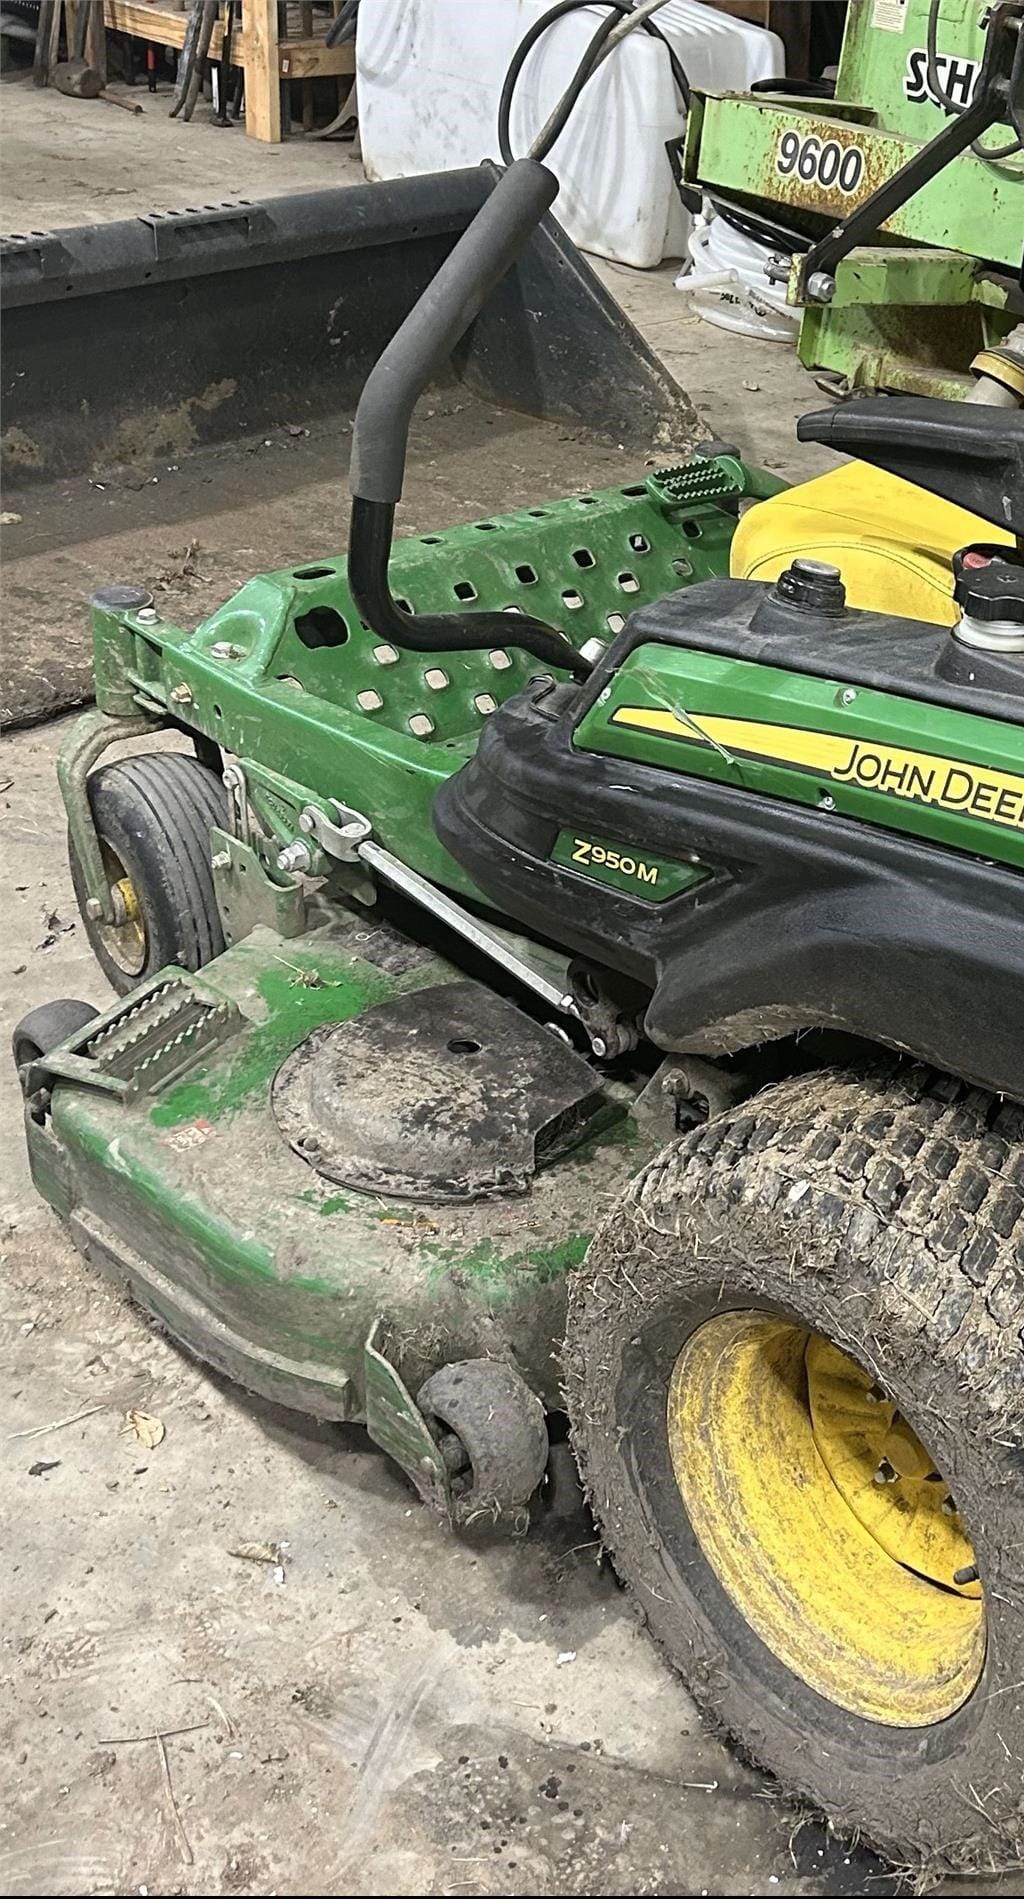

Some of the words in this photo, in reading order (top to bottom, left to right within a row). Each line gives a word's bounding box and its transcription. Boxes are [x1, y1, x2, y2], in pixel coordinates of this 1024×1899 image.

[777, 131, 862, 192] 9600
[833, 745, 936, 797] JOHN
[572, 838, 659, 885] Z950M
